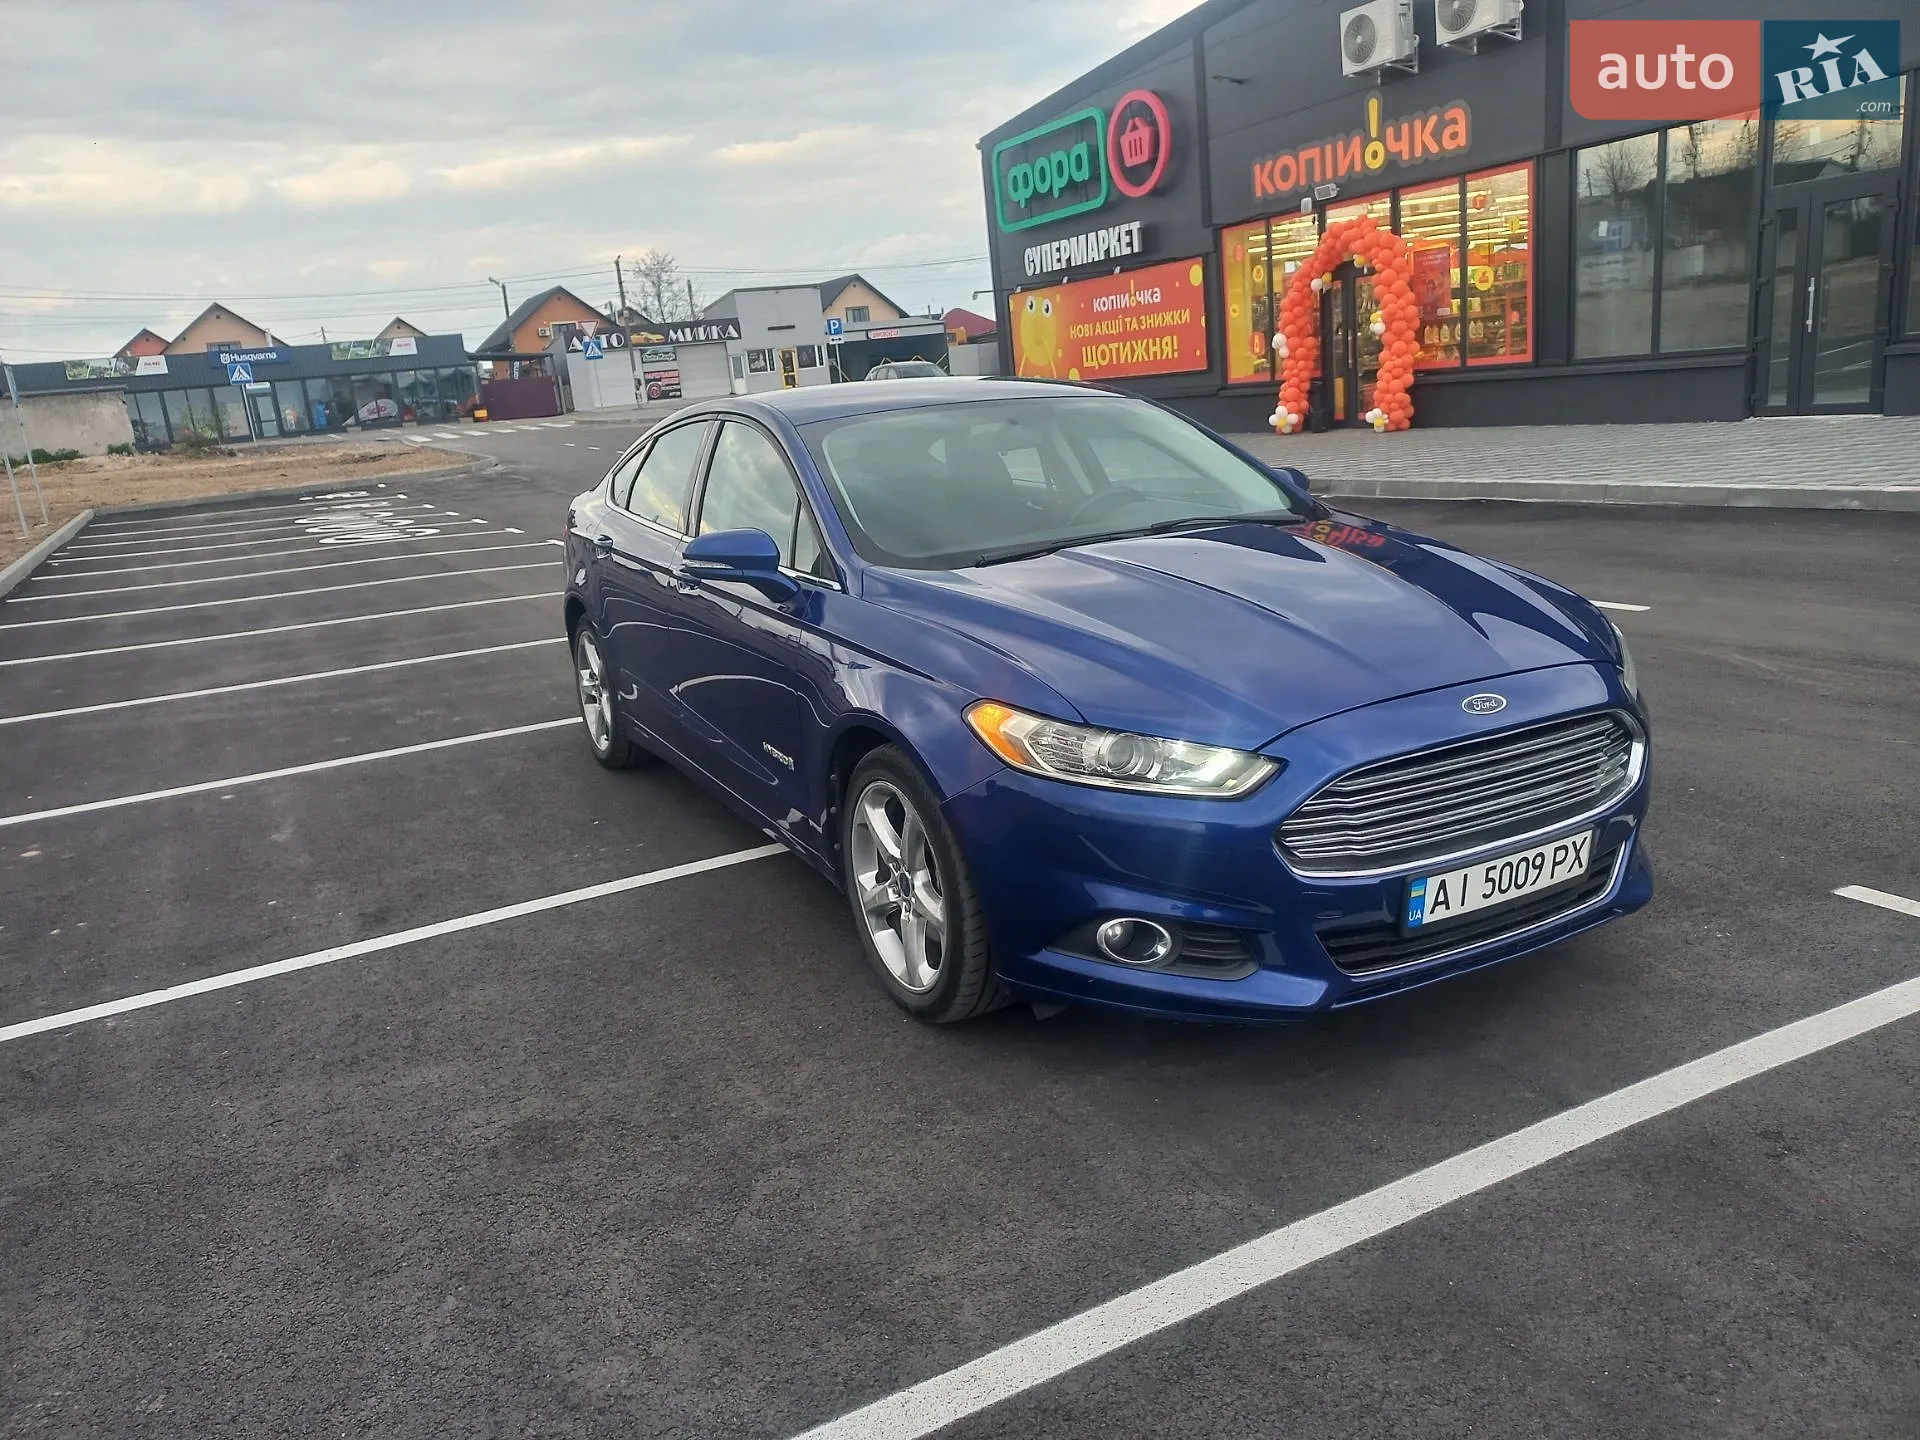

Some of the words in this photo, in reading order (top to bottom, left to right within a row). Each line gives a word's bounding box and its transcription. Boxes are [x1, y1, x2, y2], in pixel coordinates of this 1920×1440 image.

[1007, 141, 1090, 208] фора
[1024, 221, 1143, 276] СУПЕРМАРКЕТ
[568, 331, 625, 351] АТО
[667, 324, 740, 343] МИЙКА
[1069, 324, 1093, 339] НОВІ
[1094, 314, 1123, 336] АКЦІЇ
[1124, 317, 1140, 332] ТА
[1140, 308, 1191, 330] ЗНИЖКИ
[229, 351, 277, 362] Husqvarna
[1081, 335, 1179, 370] ЩОТИЖНЯ!
[1473, 698, 1497, 710] Ford
[1429, 873, 1469, 915] AI
[1482, 851, 1546, 899] 5009
[1550, 836, 1588, 880] PX
[1408, 909, 1423, 922] UA
